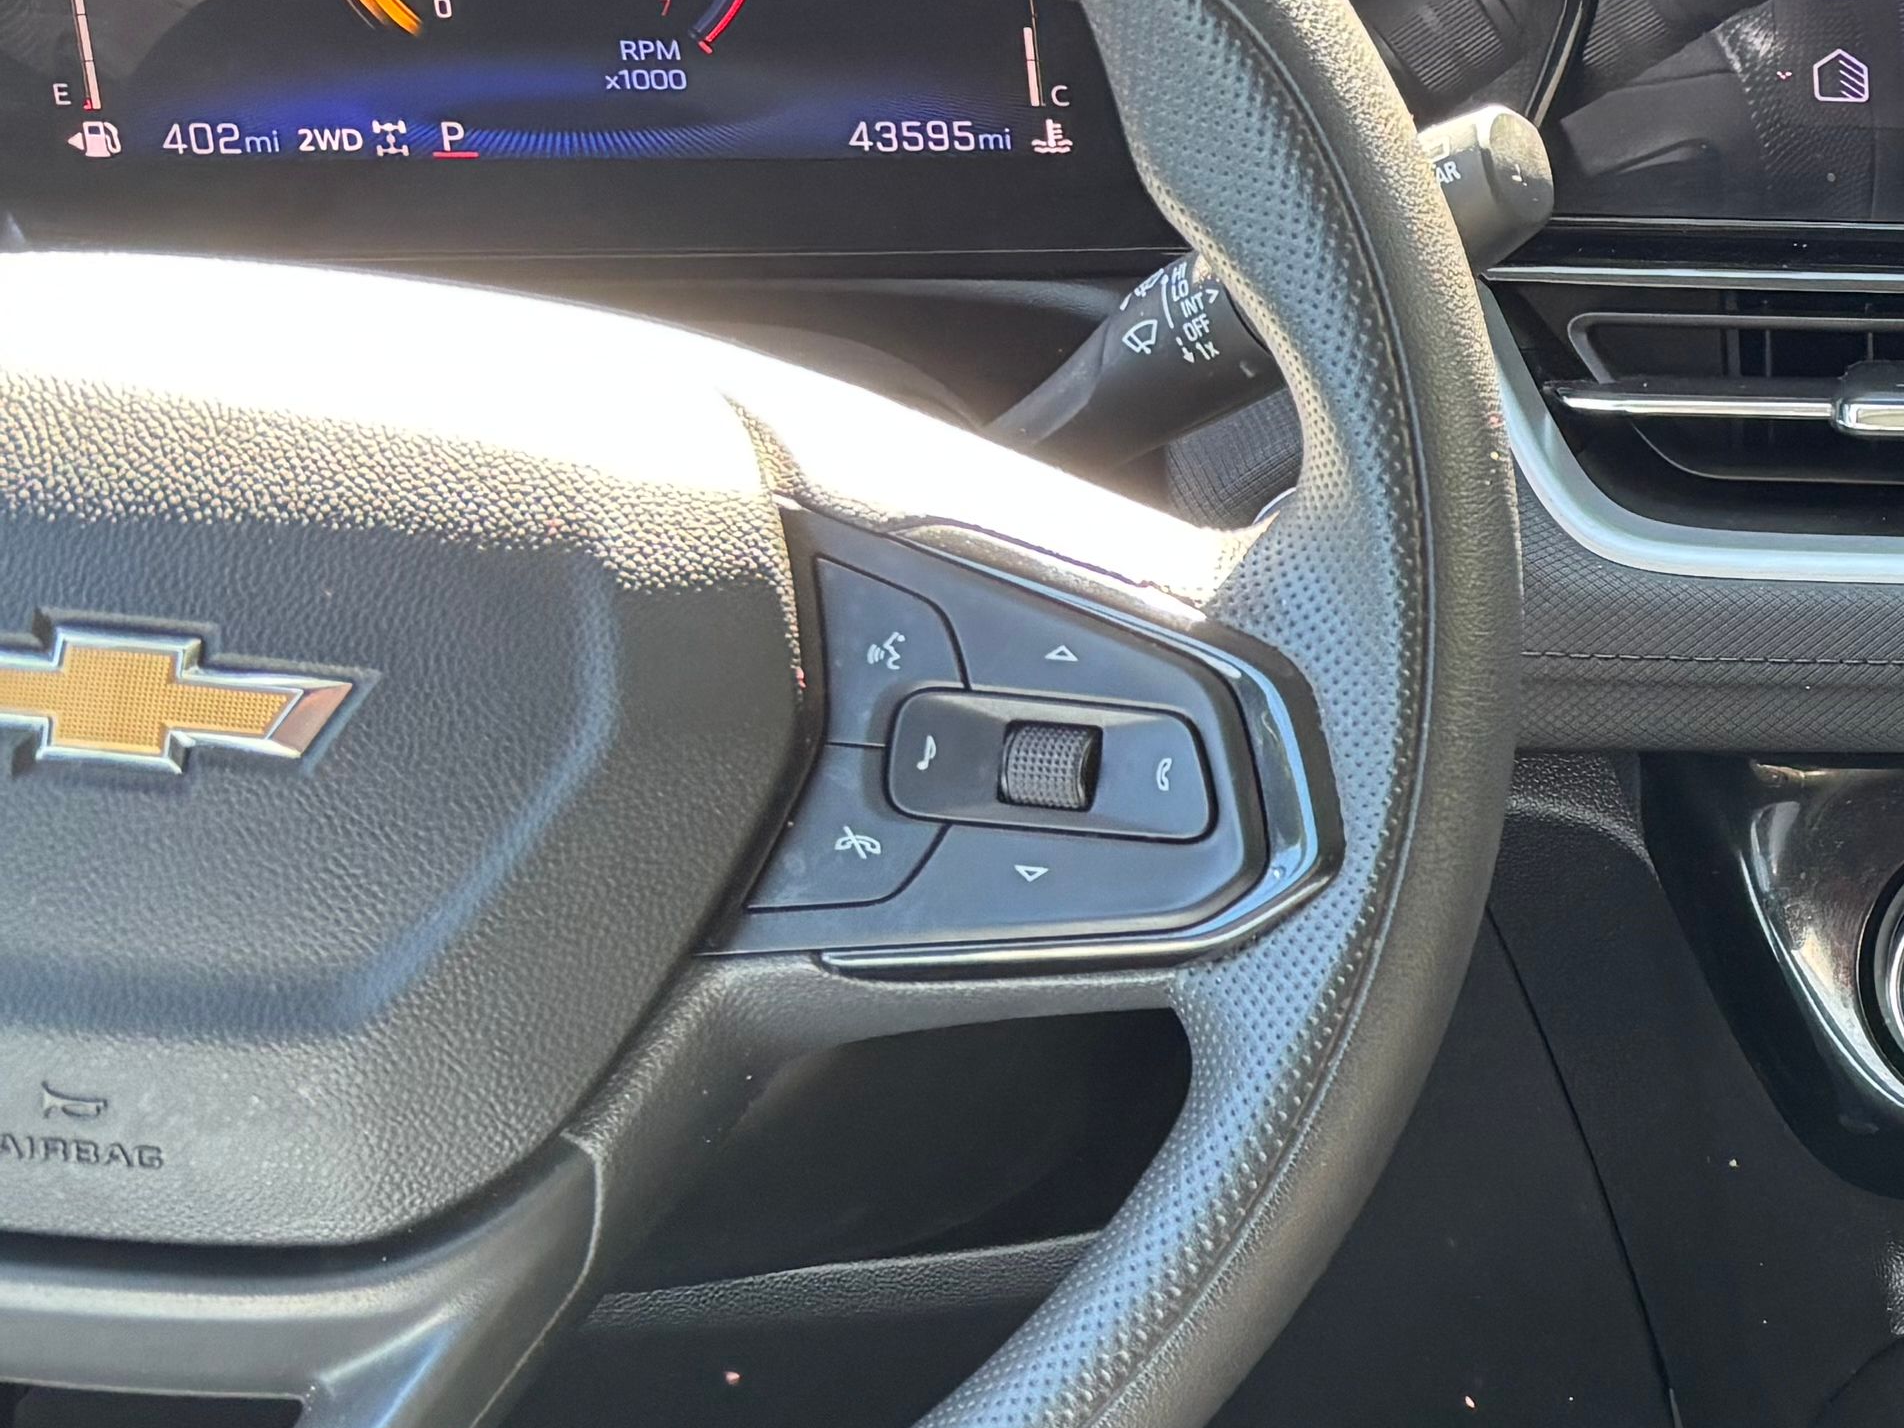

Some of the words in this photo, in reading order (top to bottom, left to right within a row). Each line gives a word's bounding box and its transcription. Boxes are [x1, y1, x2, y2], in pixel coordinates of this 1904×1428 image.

[619, 39, 682, 62] RPM
[604, 68, 687, 92] x1000
[53, 82, 72, 106] E
[1050, 85, 1071, 108] C
[298, 127, 364, 153] 2WD
[440, 121, 466, 152] P
[1435, 160, 1461, 184] AR
[1171, 262, 1188, 281] HI
[1170, 280, 1190, 302] LO
[1180, 292, 1205, 318] INT
[1182, 313, 1211, 342] OFF
[0, 1132, 164, 1170] AIRBAG
